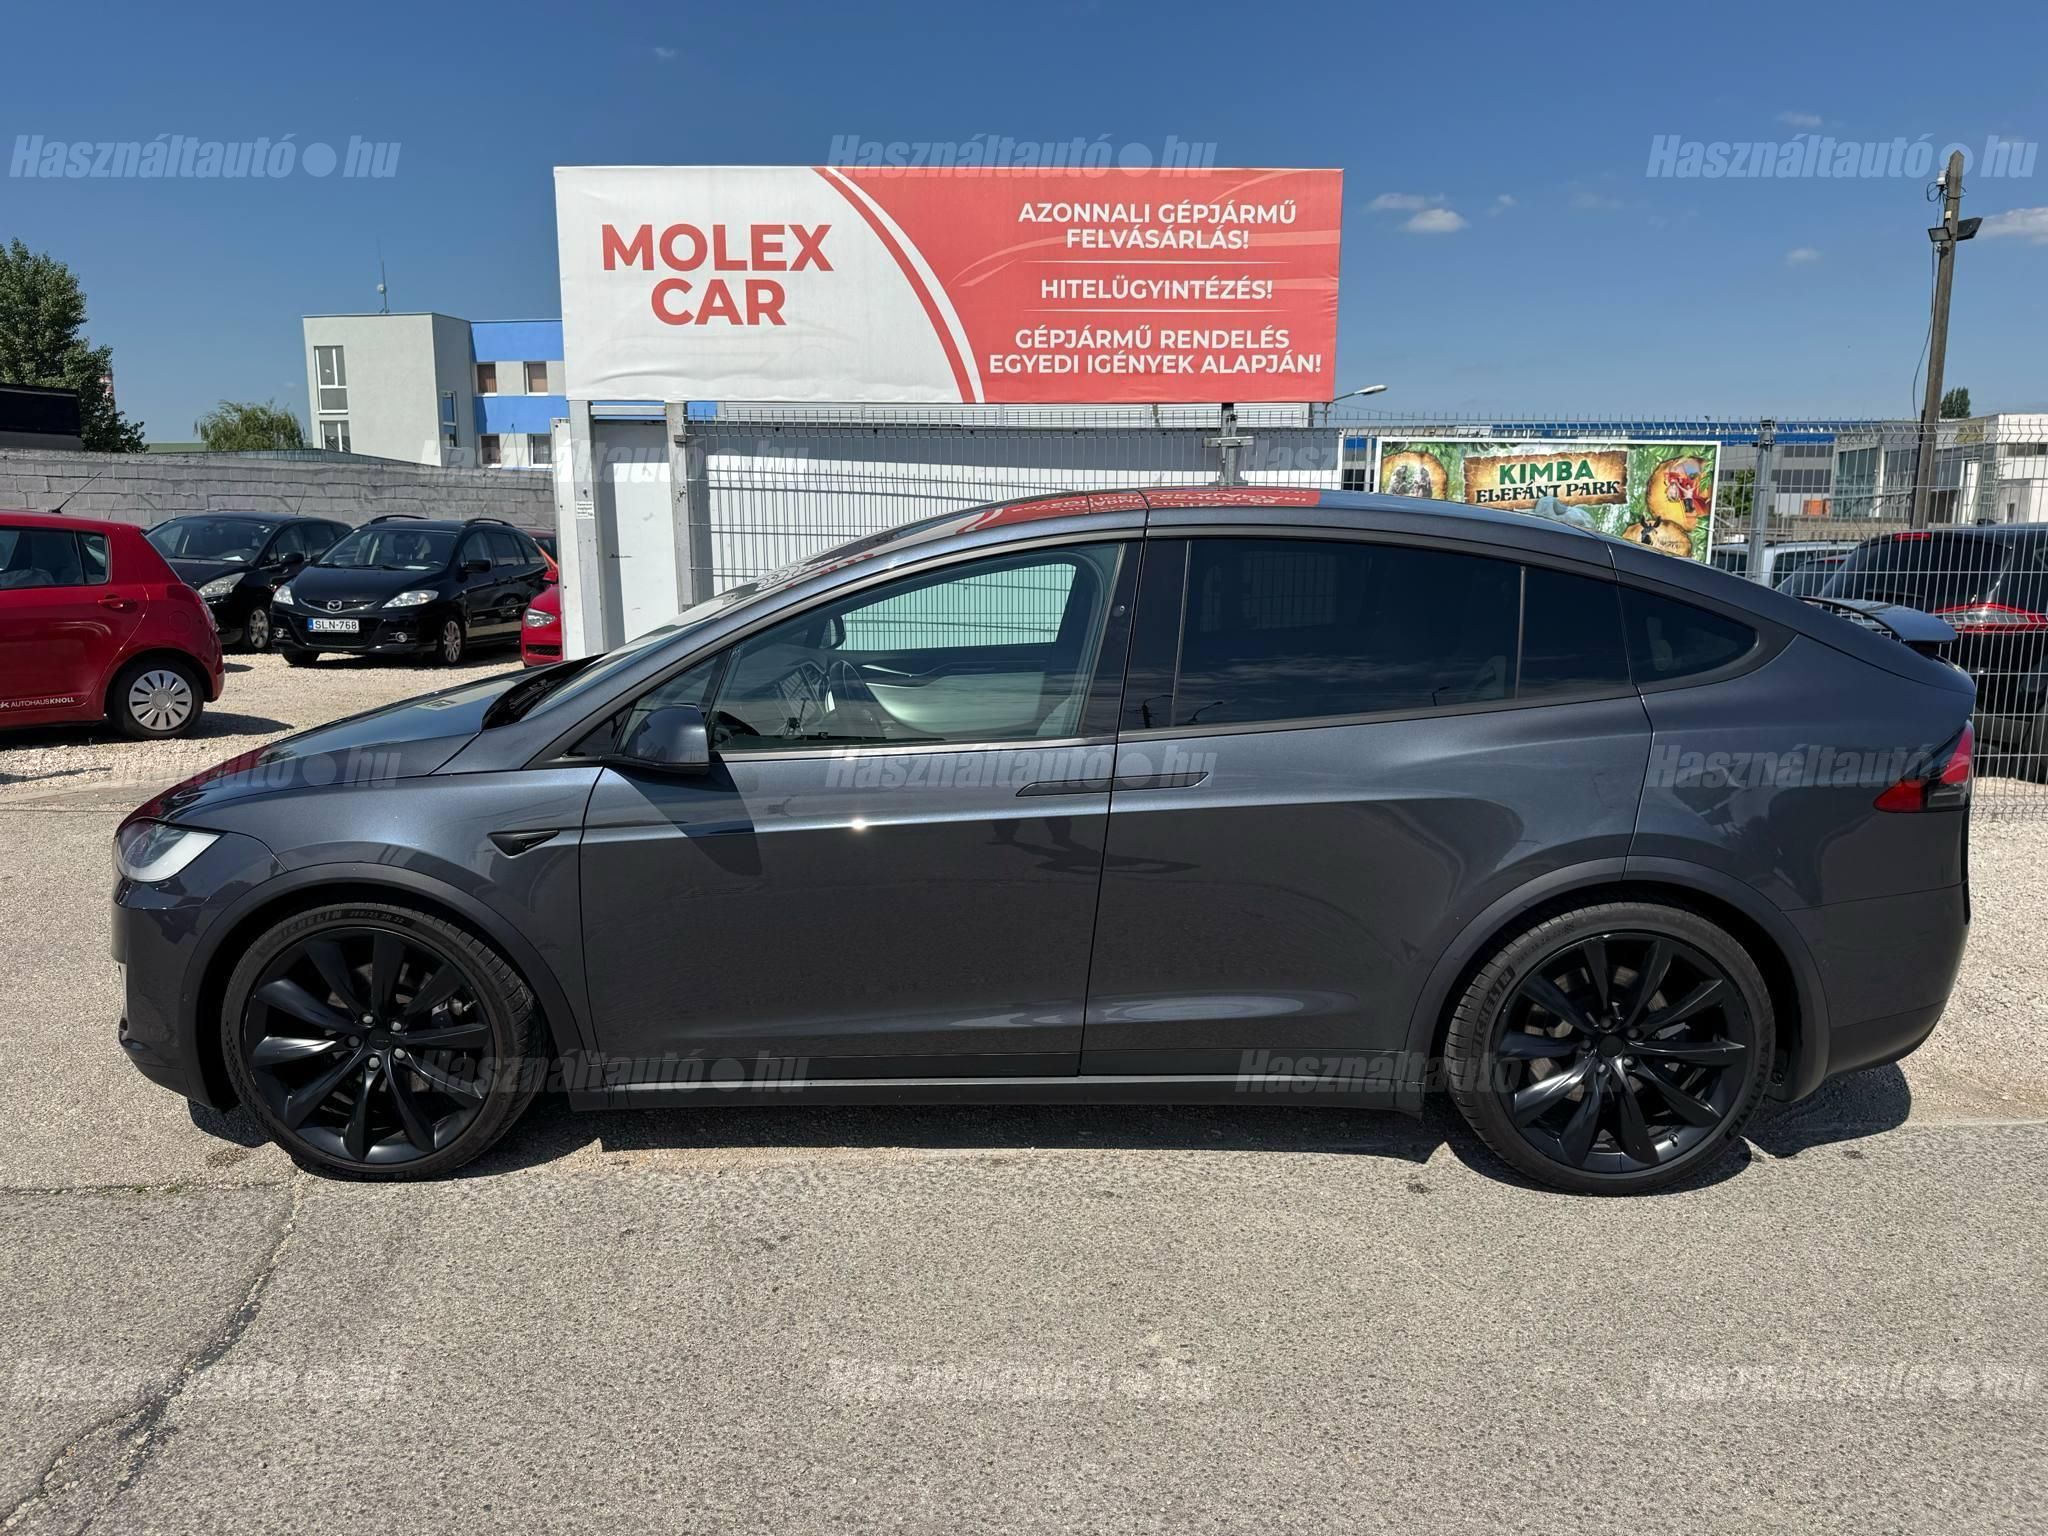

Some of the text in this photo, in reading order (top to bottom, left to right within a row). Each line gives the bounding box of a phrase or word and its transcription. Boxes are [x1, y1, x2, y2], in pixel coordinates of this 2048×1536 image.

[1018, 199, 1297, 224] AZONNALI GÉPJÁRMŰ
[602, 222, 834, 272] MOLEX
[1066, 226, 1249, 249] FELVÁSÁRLÁS!
[1041, 274, 1273, 299] HITELÜGYINTÉZÉS!
[651, 277, 787, 326] CAR
[1014, 324, 1289, 349] GÉPJÁRMŰ RENDELÉS
[989, 350, 1322, 375] EGYEDI IGÉNYEK ALAPJÁN!
[1499, 459, 1595, 485] KIMBA
[1476, 480, 1620, 503] ELEFÁNT PARK
[314, 620, 357, 630] SLN-768
